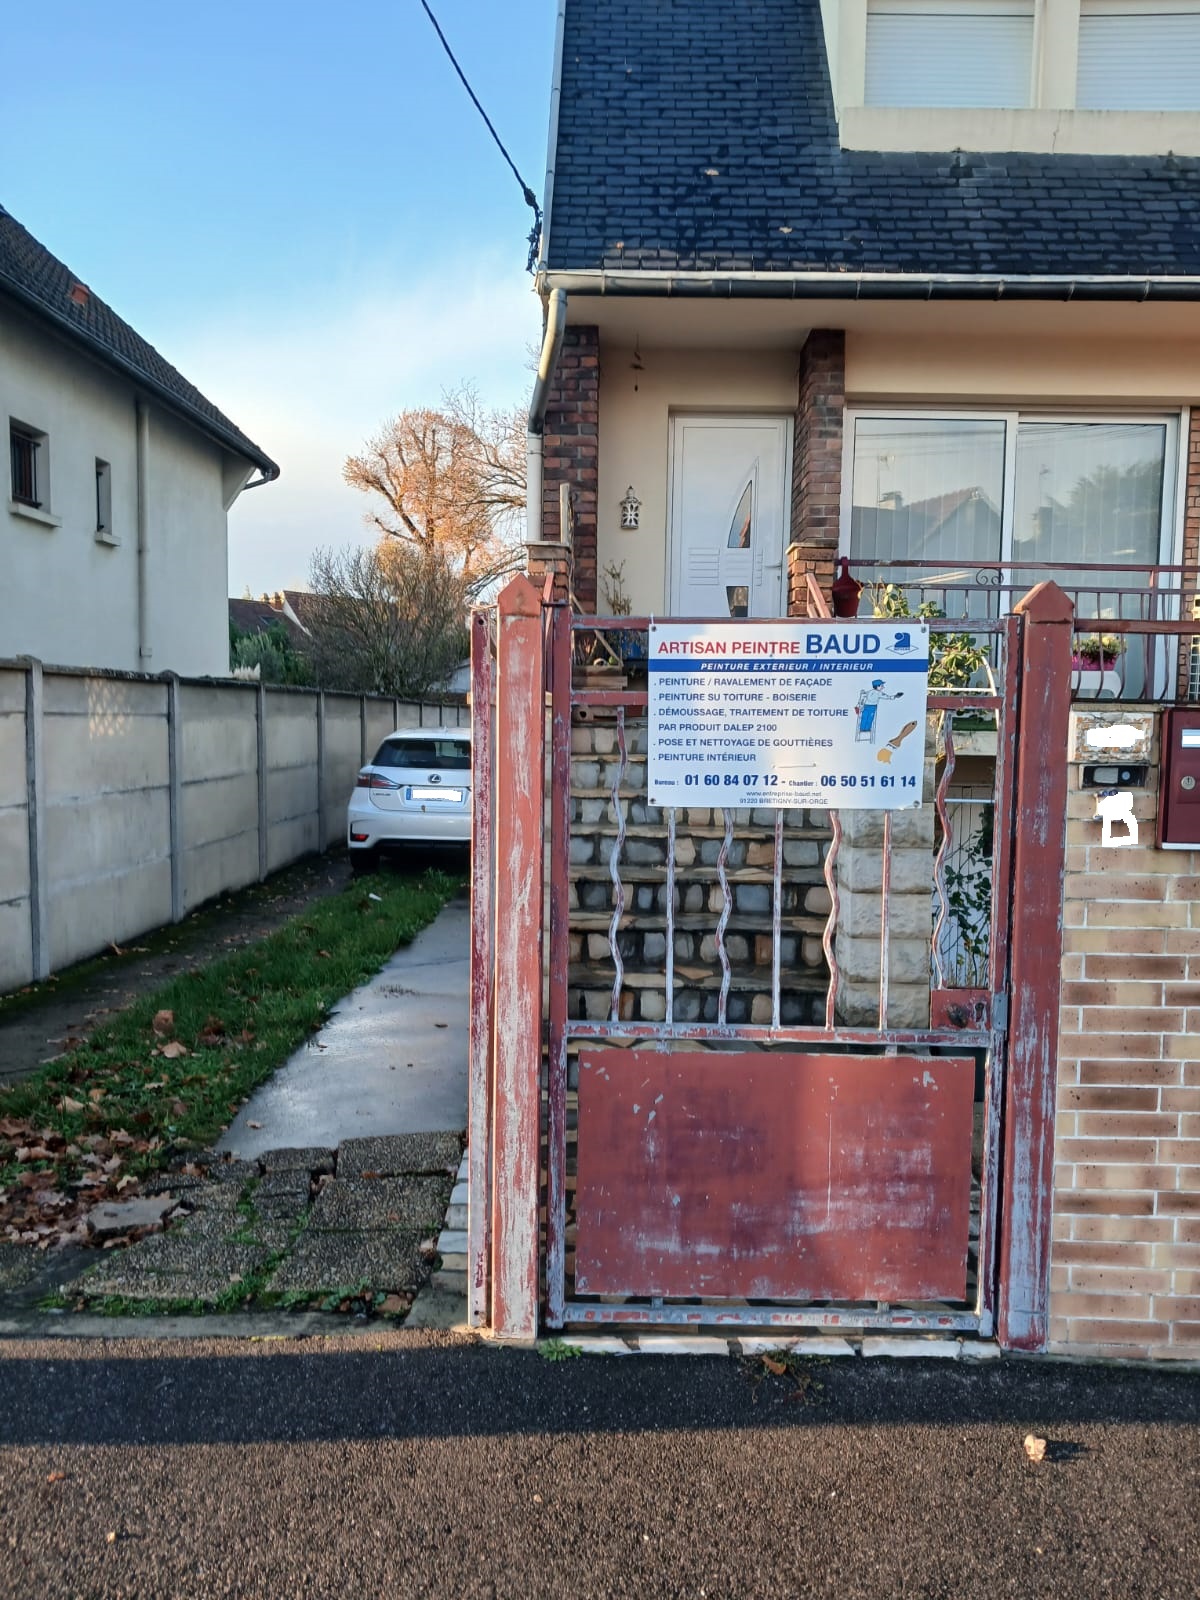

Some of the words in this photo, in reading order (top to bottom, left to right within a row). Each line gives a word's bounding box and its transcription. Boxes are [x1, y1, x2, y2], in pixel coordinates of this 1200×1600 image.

[658, 642, 726, 654] ARTISAN
[732, 642, 800, 654] PEINTRE
[806, 634, 881, 654] BAUD
[660, 678, 705, 686] PEINTURE
[714, 678, 776, 686] RAVALEMENT
[779, 678, 792, 686] DE
[794, 678, 832, 688] FAÇADE
[659, 707, 727, 717] DÉMOUSSAGE,
[730, 708, 789, 716] TRAITEMENT
[773, 737, 833, 747] GOUTTIÈRES
[707, 752, 756, 761] INTÉRIEUR
[685, 775, 699, 786] 01
[704, 775, 720, 786] 60
[724, 775, 739, 786] 84
[743, 775, 758, 786] 07
[763, 775, 778, 786] 12
[821, 776, 836, 787] 06
[841, 776, 856, 787] 50
[860, 776, 875, 787] 51
[880, 776, 895, 787] 61
[901, 776, 916, 787] 14
